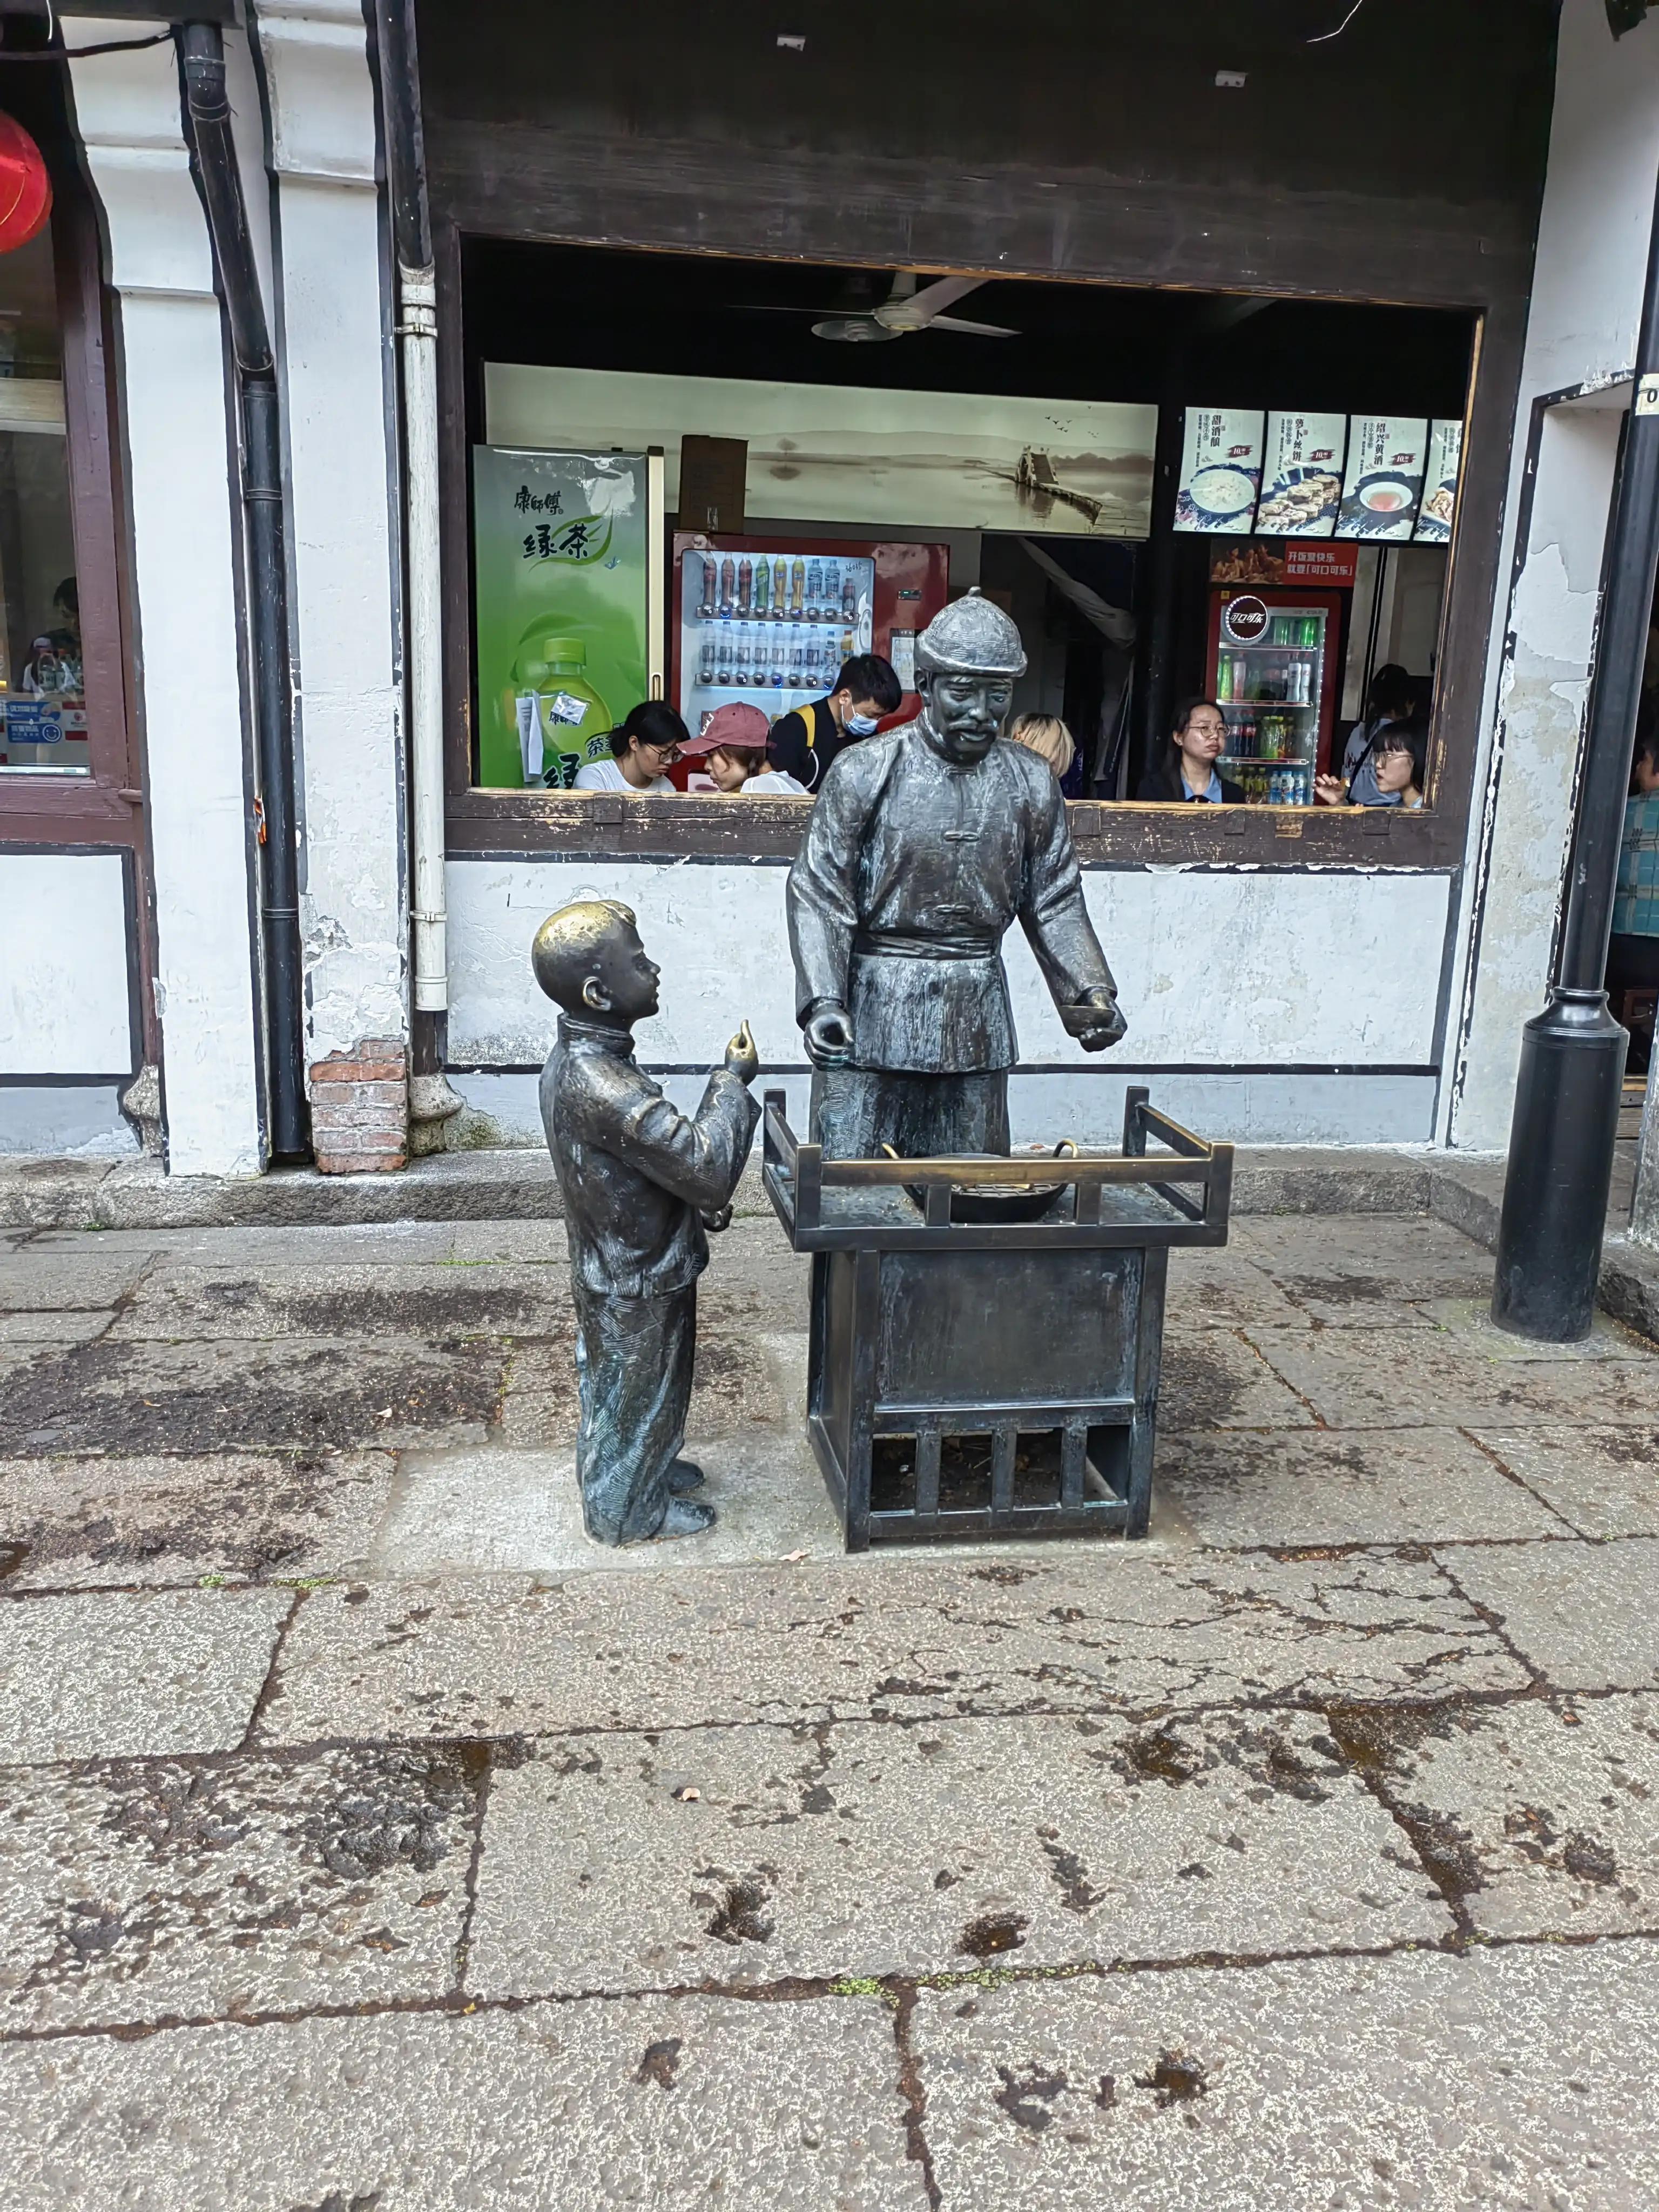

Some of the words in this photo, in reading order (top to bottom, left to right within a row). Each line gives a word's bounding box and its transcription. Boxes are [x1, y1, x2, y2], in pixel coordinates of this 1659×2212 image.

[1292, 419, 1304, 462] 萝卜丝饼
[1374, 422, 1385, 466] 绍兴黄酒
[522, 523, 590, 559] 绿茶
[1230, 612, 1265, 624] 可口可乐
